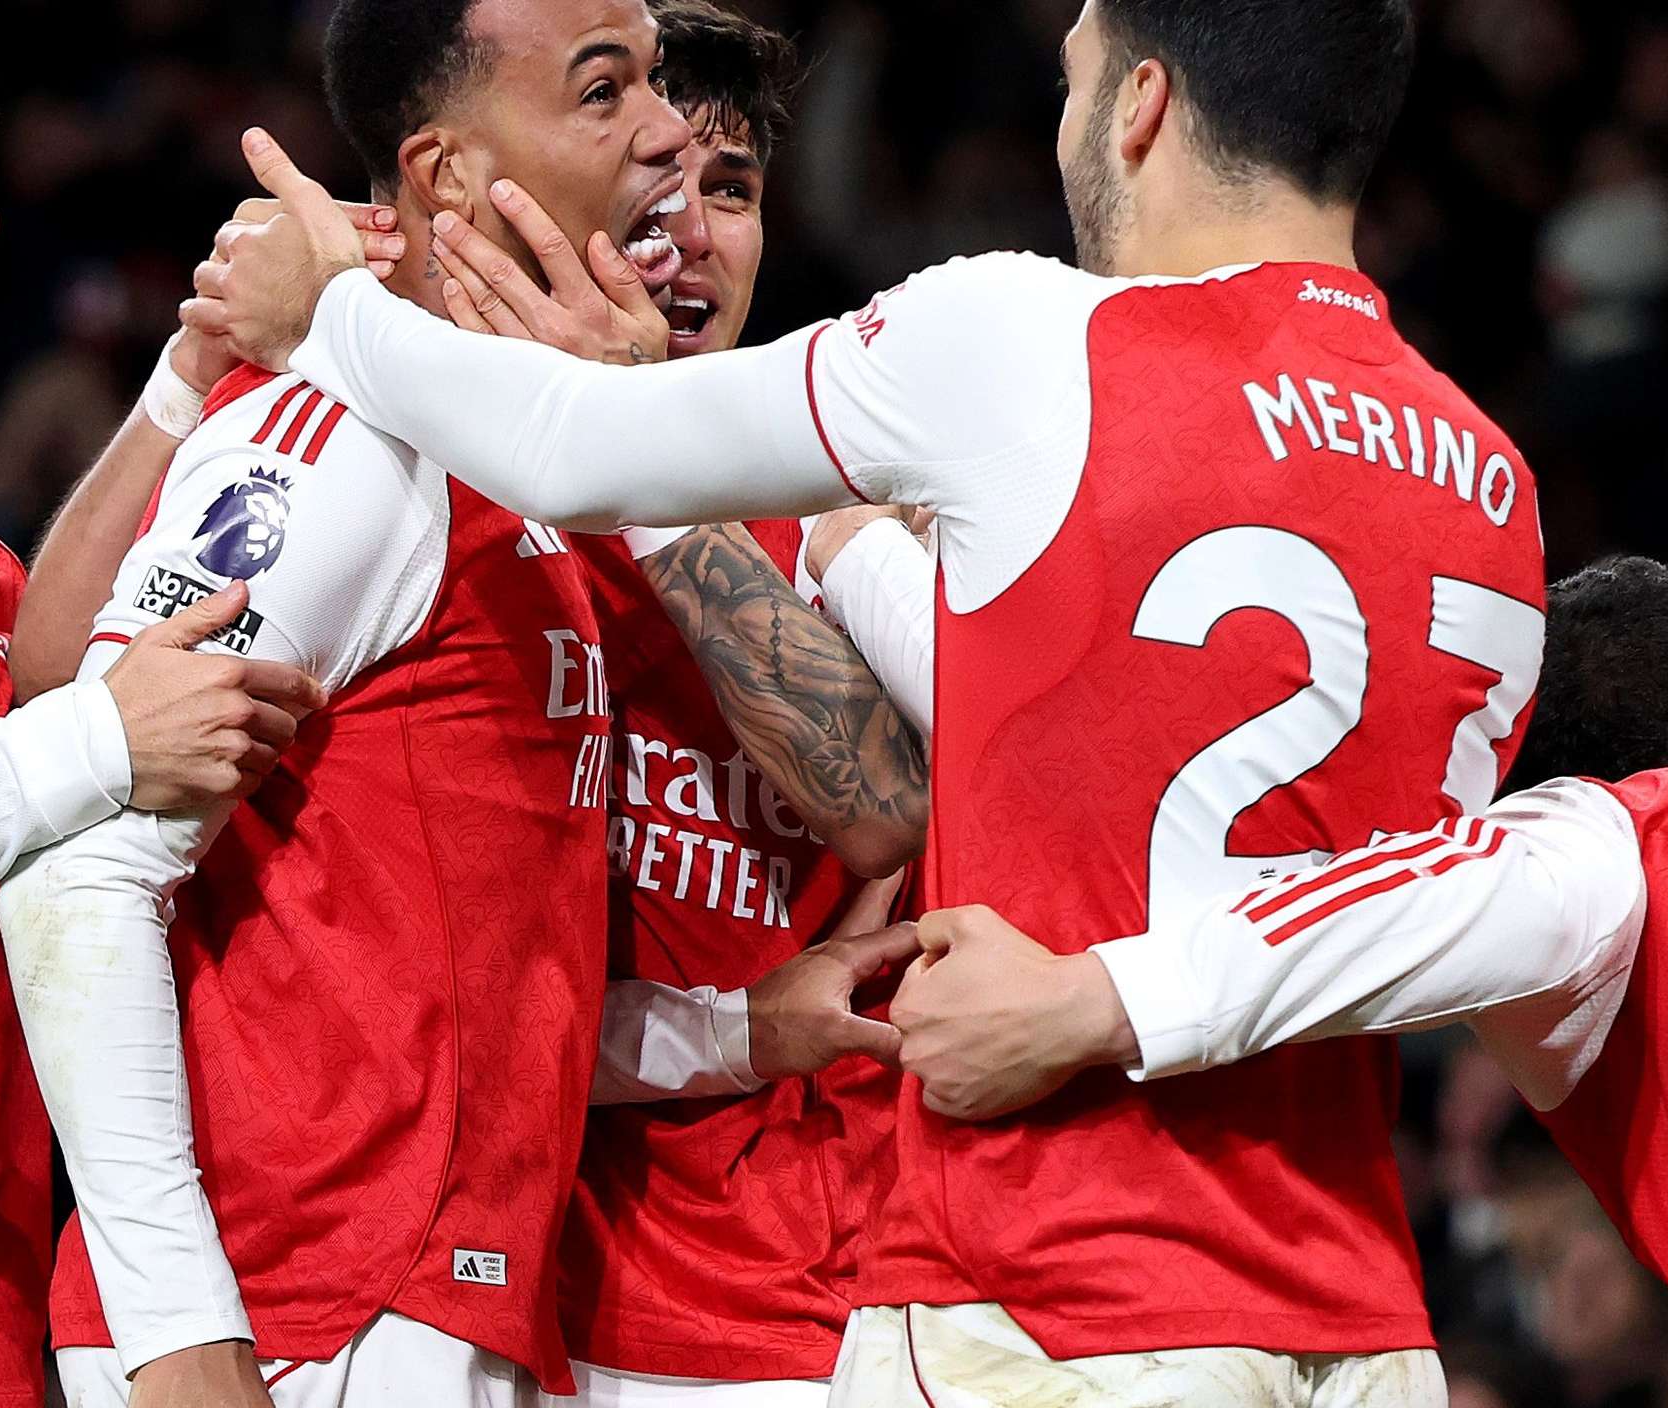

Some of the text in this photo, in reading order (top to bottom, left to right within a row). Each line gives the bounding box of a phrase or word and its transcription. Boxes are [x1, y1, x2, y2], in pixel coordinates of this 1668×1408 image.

[1243, 373, 1516, 527] MERINO
[141, 566, 182, 597] No
[134, 586, 174, 615] for
